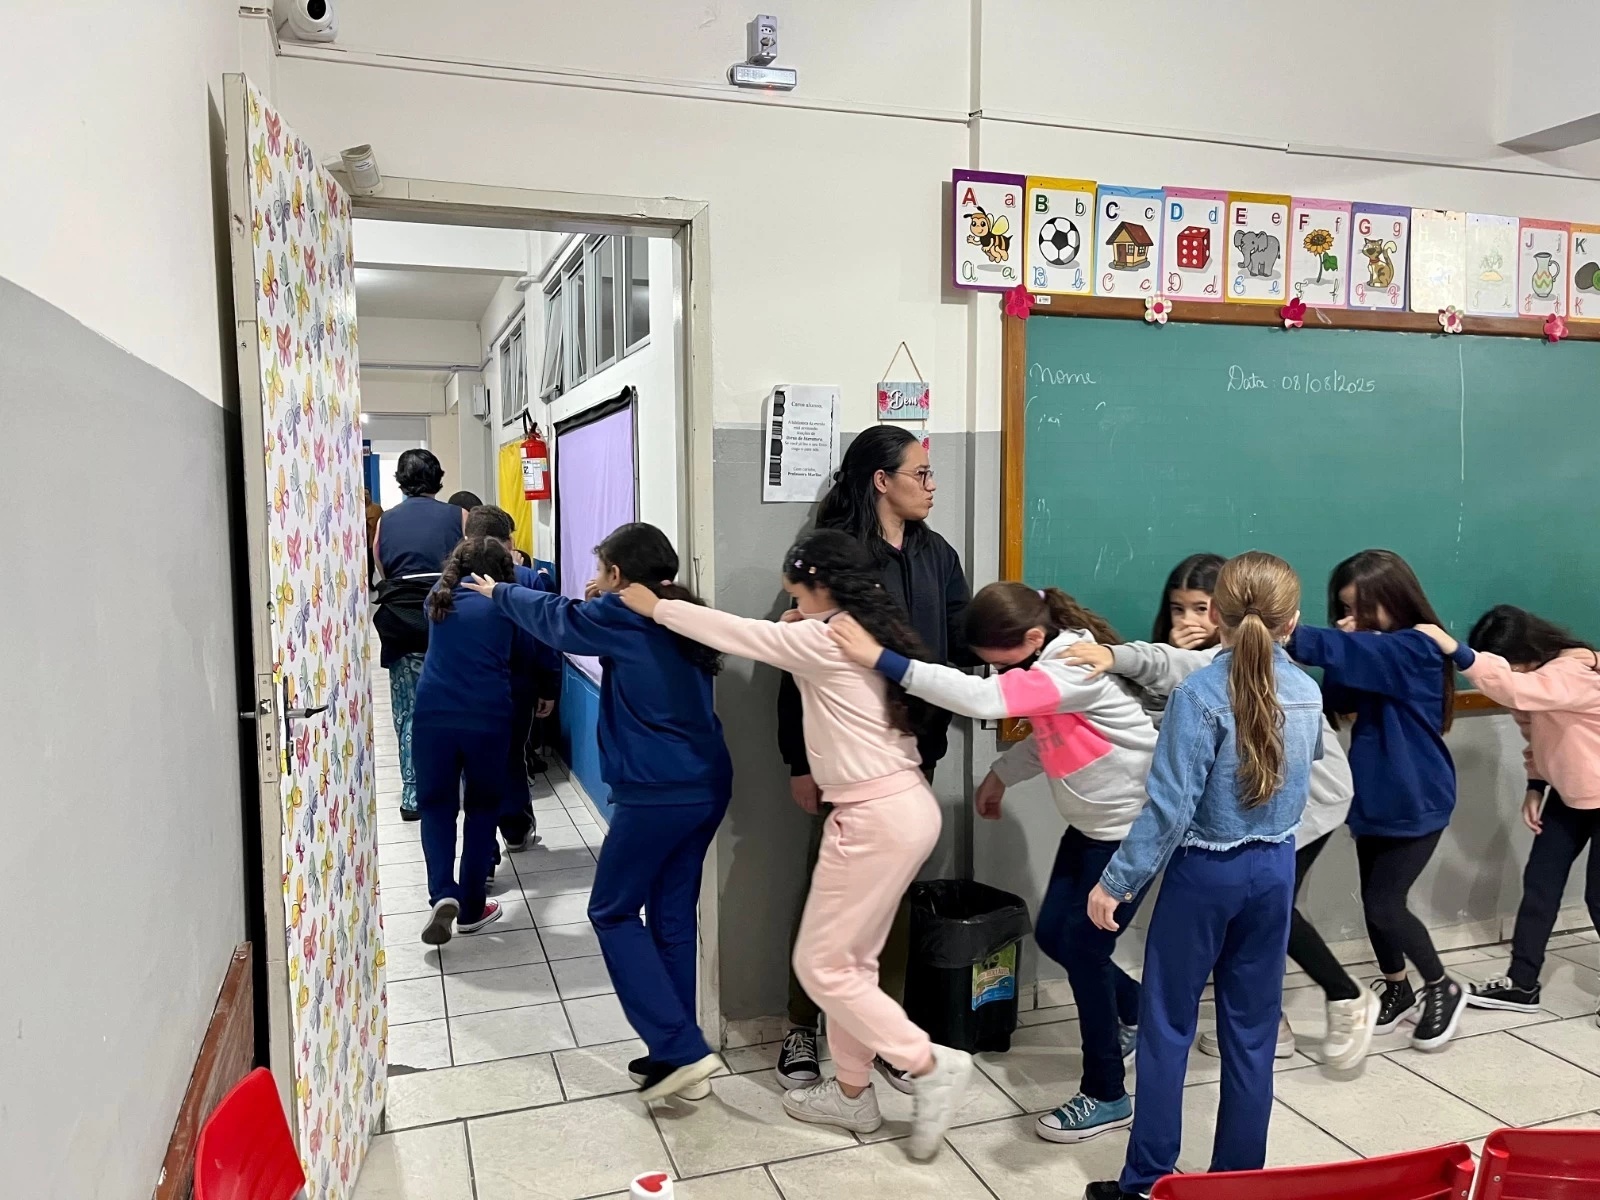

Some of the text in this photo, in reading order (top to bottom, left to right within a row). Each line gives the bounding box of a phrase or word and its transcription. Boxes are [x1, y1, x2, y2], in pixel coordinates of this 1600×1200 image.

[962, 187, 1014, 206] A a
[1035, 194, 1085, 214] B b
[1105, 202, 1154, 219] C c
[1170, 203, 1218, 222] D d
[1235, 207, 1281, 224] E e
[1299, 214, 1341, 232] F f
[1359, 218, 1401, 236] G g
[1525, 233, 1562, 252] J j
[1575, 237, 1585, 253] K
[1033, 266, 1084, 289] B b
[1102, 272, 1152, 292] C c
[1168, 272, 1217, 293] D d
[1233, 275, 1279, 295] E e
[1388, 285, 1399, 305] g
[1281, 369, 1376, 394] 08/08/2025
[889, 389, 919, 411] Bem
